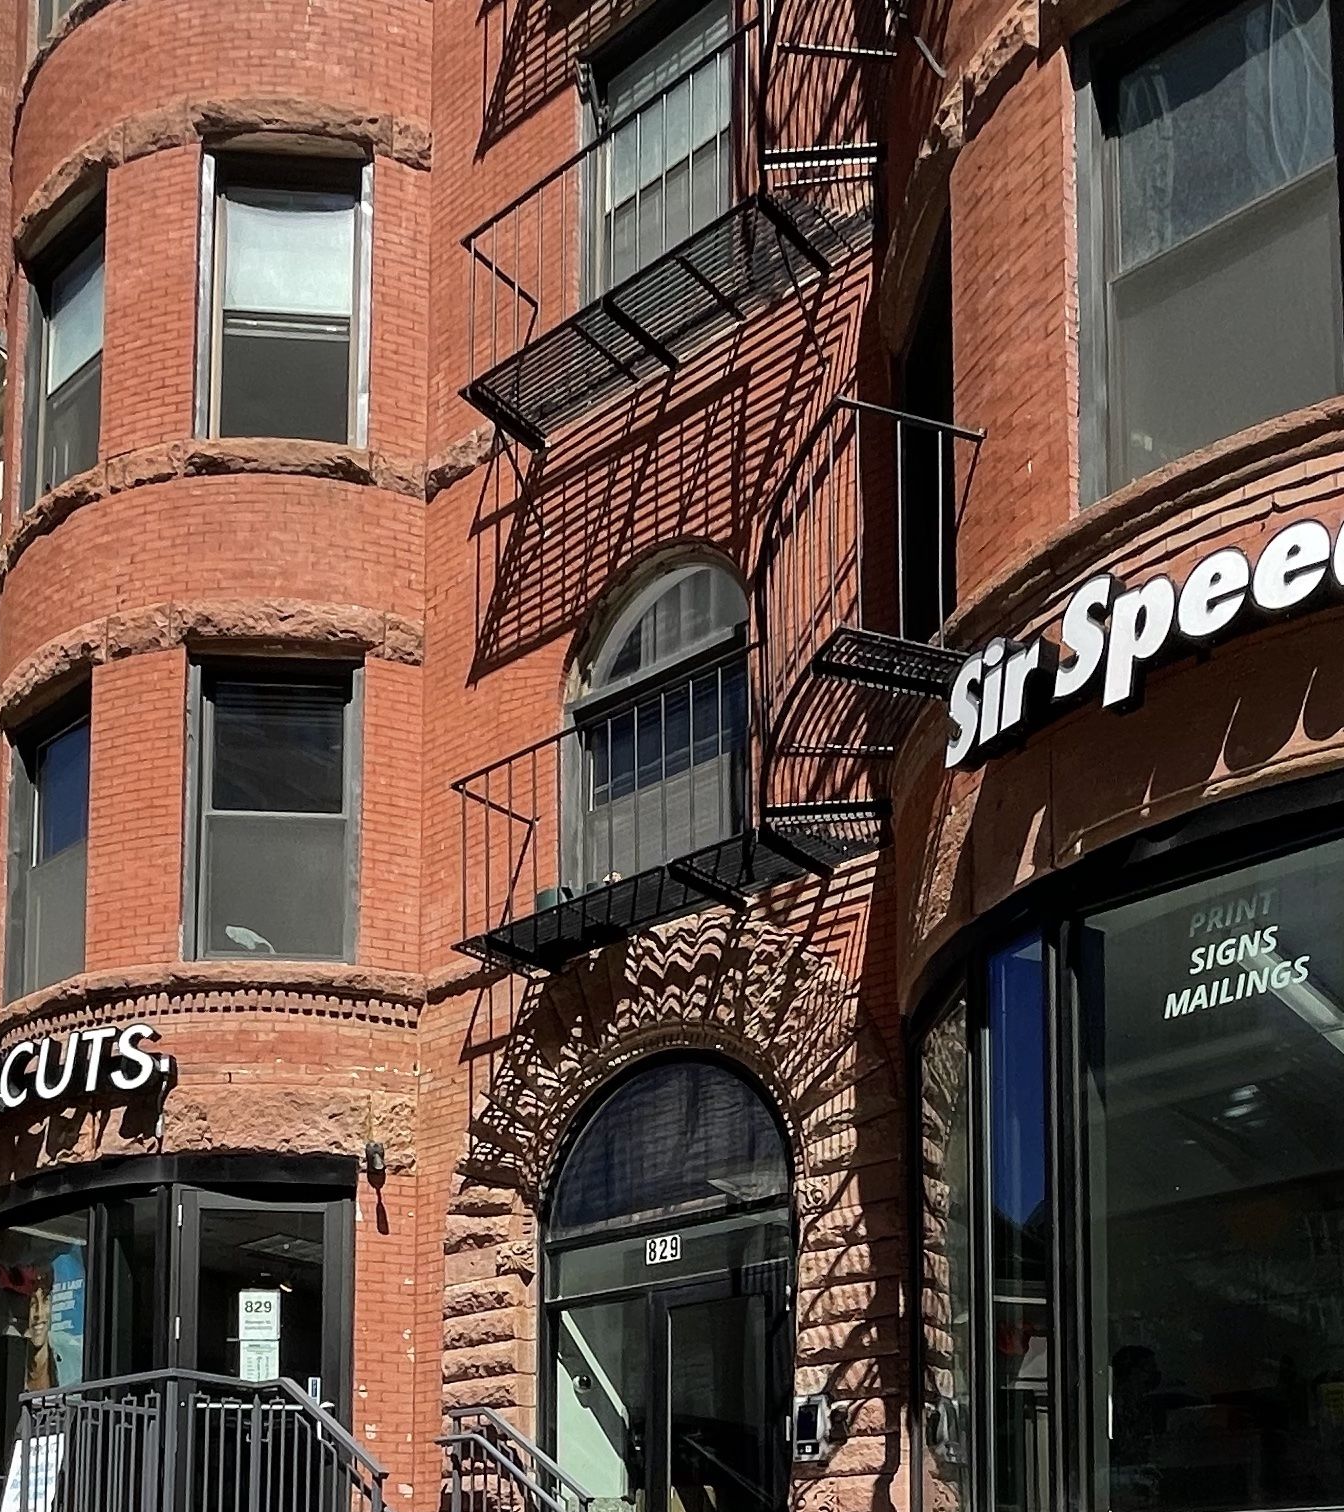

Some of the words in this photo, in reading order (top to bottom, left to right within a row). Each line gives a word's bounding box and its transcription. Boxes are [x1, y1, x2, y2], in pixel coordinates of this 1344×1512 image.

[945, 636, 1044, 769] Sir
[1188, 888, 1281, 940] PRINT
[1188, 926, 1280, 976] SIGNS
[1163, 956, 1311, 1021] MAILINGS
[647, 1236, 679, 1262] 829
[244, 1300, 272, 1313] 829
